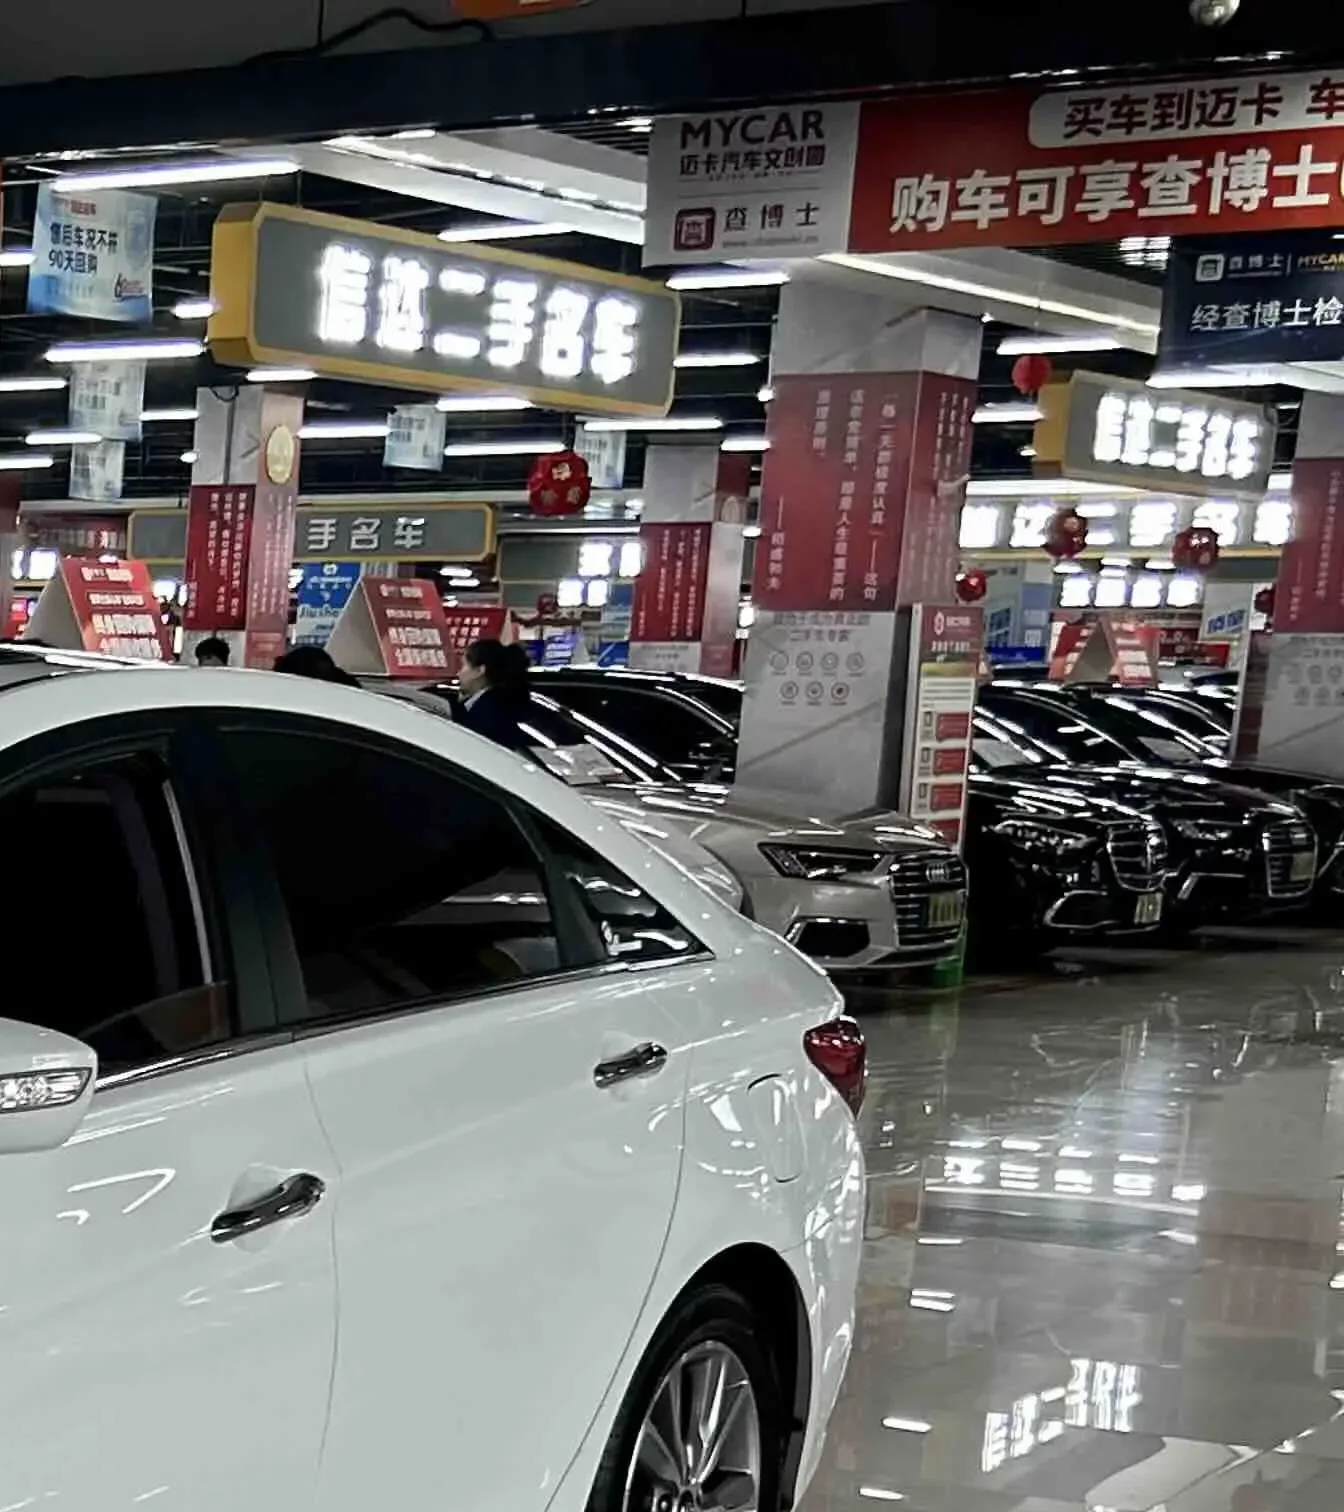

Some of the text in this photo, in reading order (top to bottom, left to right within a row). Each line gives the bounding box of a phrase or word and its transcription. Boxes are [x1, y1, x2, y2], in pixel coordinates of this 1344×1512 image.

[680, 109, 825, 149] MYCAR
[1064, 82, 1282, 139] 买车到迈卡
[889, 143, 1337, 235] 购车可享查博士
[724, 202, 820, 233] 查博士
[318, 242, 640, 384] 信达二手名车
[1190, 295, 1344, 333] 经查博士检
